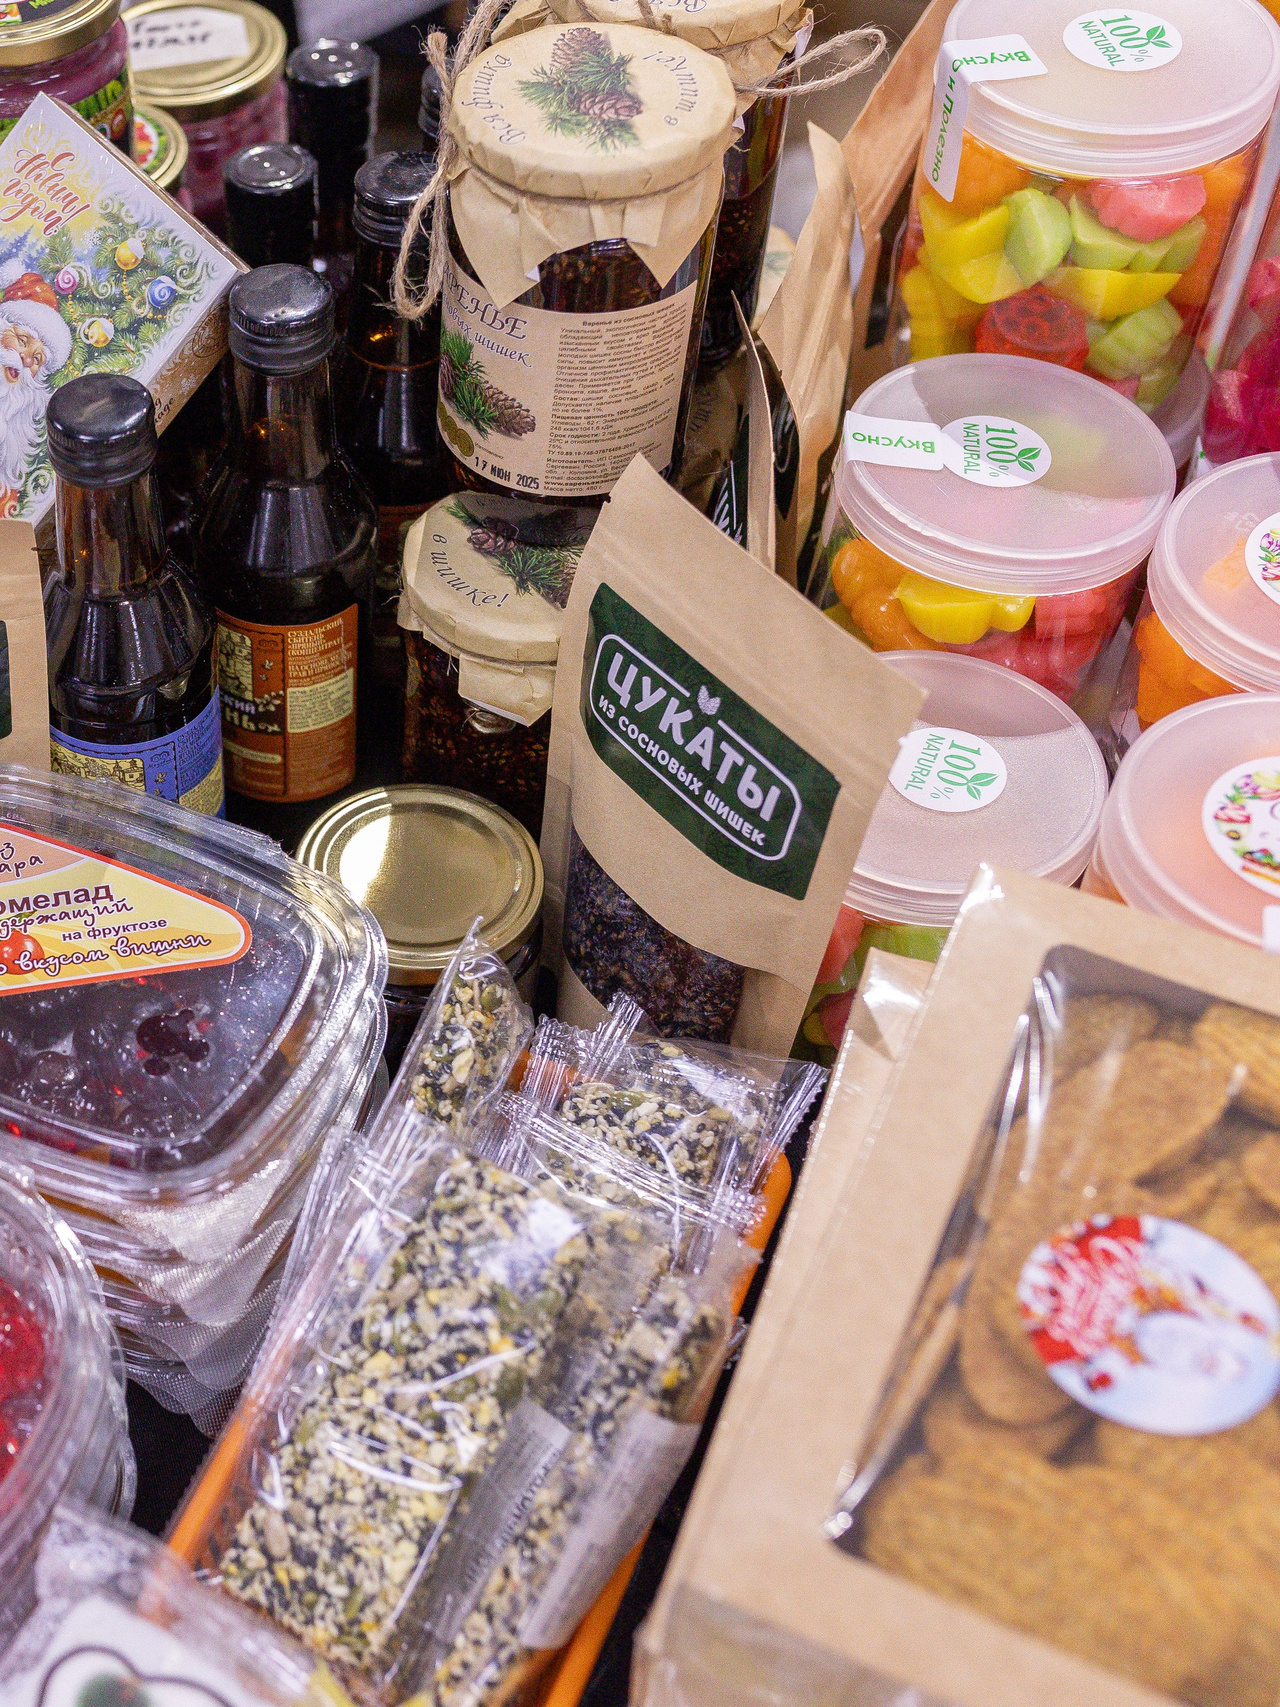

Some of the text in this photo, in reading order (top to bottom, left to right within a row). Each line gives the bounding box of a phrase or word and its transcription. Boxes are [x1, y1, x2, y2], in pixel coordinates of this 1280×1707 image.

[952, 50, 1031, 73] Вкусно
[1077, 20, 1127, 67] NATURAL
[461, 50, 699, 145] Вся фишка в шишке!
[51, 152, 75, 171] С
[931, 94, 954, 182] Полезно
[14, 149, 79, 214] Новым
[0, 178, 90, 236] годом!
[443, 260, 527, 340] АРЕНЬЕ
[474, 332, 532, 368] шишек
[852, 430, 937, 455] Вкусно
[962, 422, 982, 476] NATURAL
[516, 473, 540, 491] 2025
[432, 533, 447, 544] в
[430, 550, 509, 608] шишке!
[607, 652, 781, 822] ЦУКАТЫ
[904, 733, 946, 792] NATURAL
[15, 946, 109, 979] вкусом
[111, 932, 213, 958] вишни
[61, 919, 168, 943] на фруктозе
